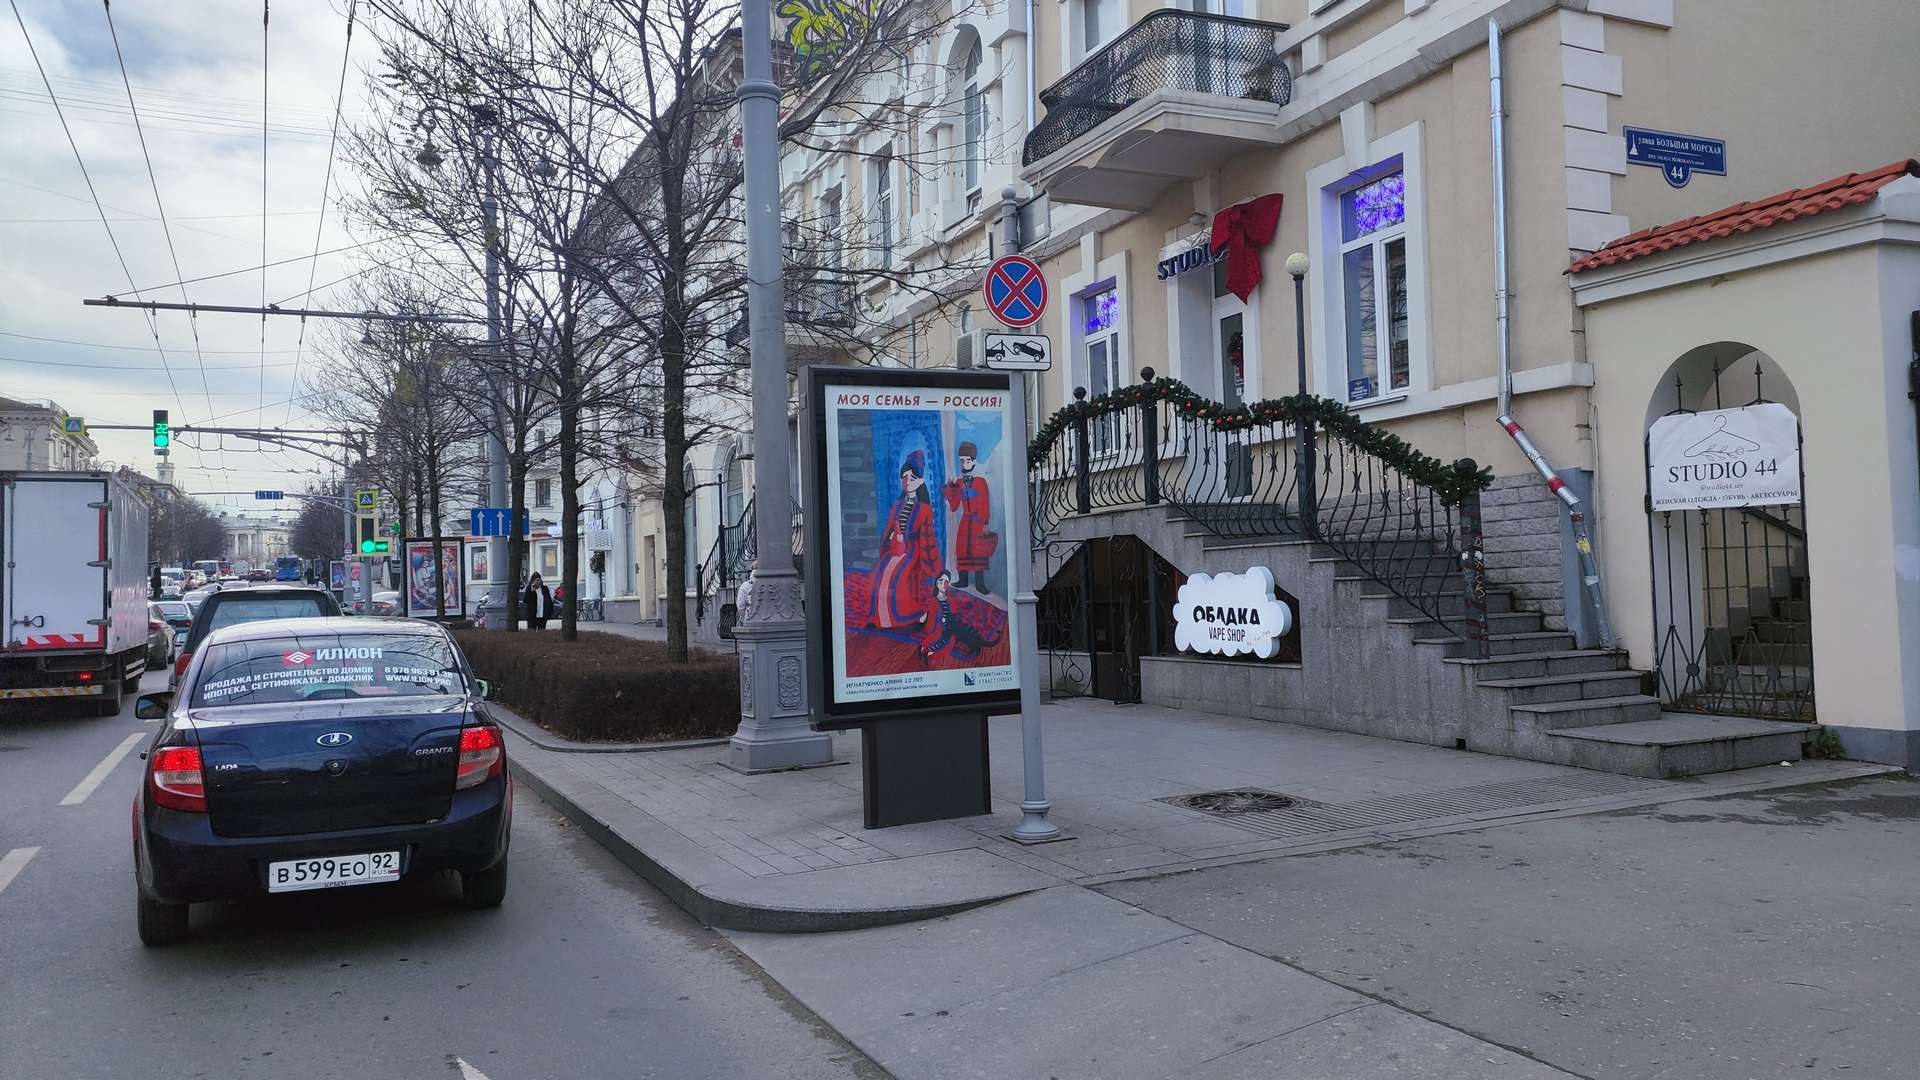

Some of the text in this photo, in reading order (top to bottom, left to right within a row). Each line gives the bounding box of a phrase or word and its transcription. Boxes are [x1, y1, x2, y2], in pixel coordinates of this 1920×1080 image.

[1656, 138, 1688, 150] БОЛЬШАЯ
[1690, 144, 1721, 154] МОРСКАЯ
[1670, 166, 1683, 179] 44
[837, 394, 870, 406] МОЯ
[876, 394, 920, 406] СЕМЬЯ
[943, 396, 1002, 407] РОССИЯ!
[1668, 458, 1778, 483] STUDIO 44
[1656, 497, 1687, 505] ЖЕНСКАЯ
[1750, 490, 1798, 500] АКСЕССУАРЫ
[1193, 605, 1260, 626] ОБЛАКА
[1208, 626, 1246, 642] VAPE SHOP
[317, 648, 382, 660] ИЛИОН
[204, 675, 252, 692] ПРОДАЖА
[262, 666, 339, 680] СТРОИТЕЛЬСТВО
[341, 666, 374, 674] ДОМОВ
[385, 674, 451, 686] WWW.ILION.PRO
[203, 685, 249, 700] ИПОТЕКА.
[327, 674, 374, 683] ДОМКЛИК
[415, 746, 453, 756] GRANTA
[372, 854, 392, 869] 92
